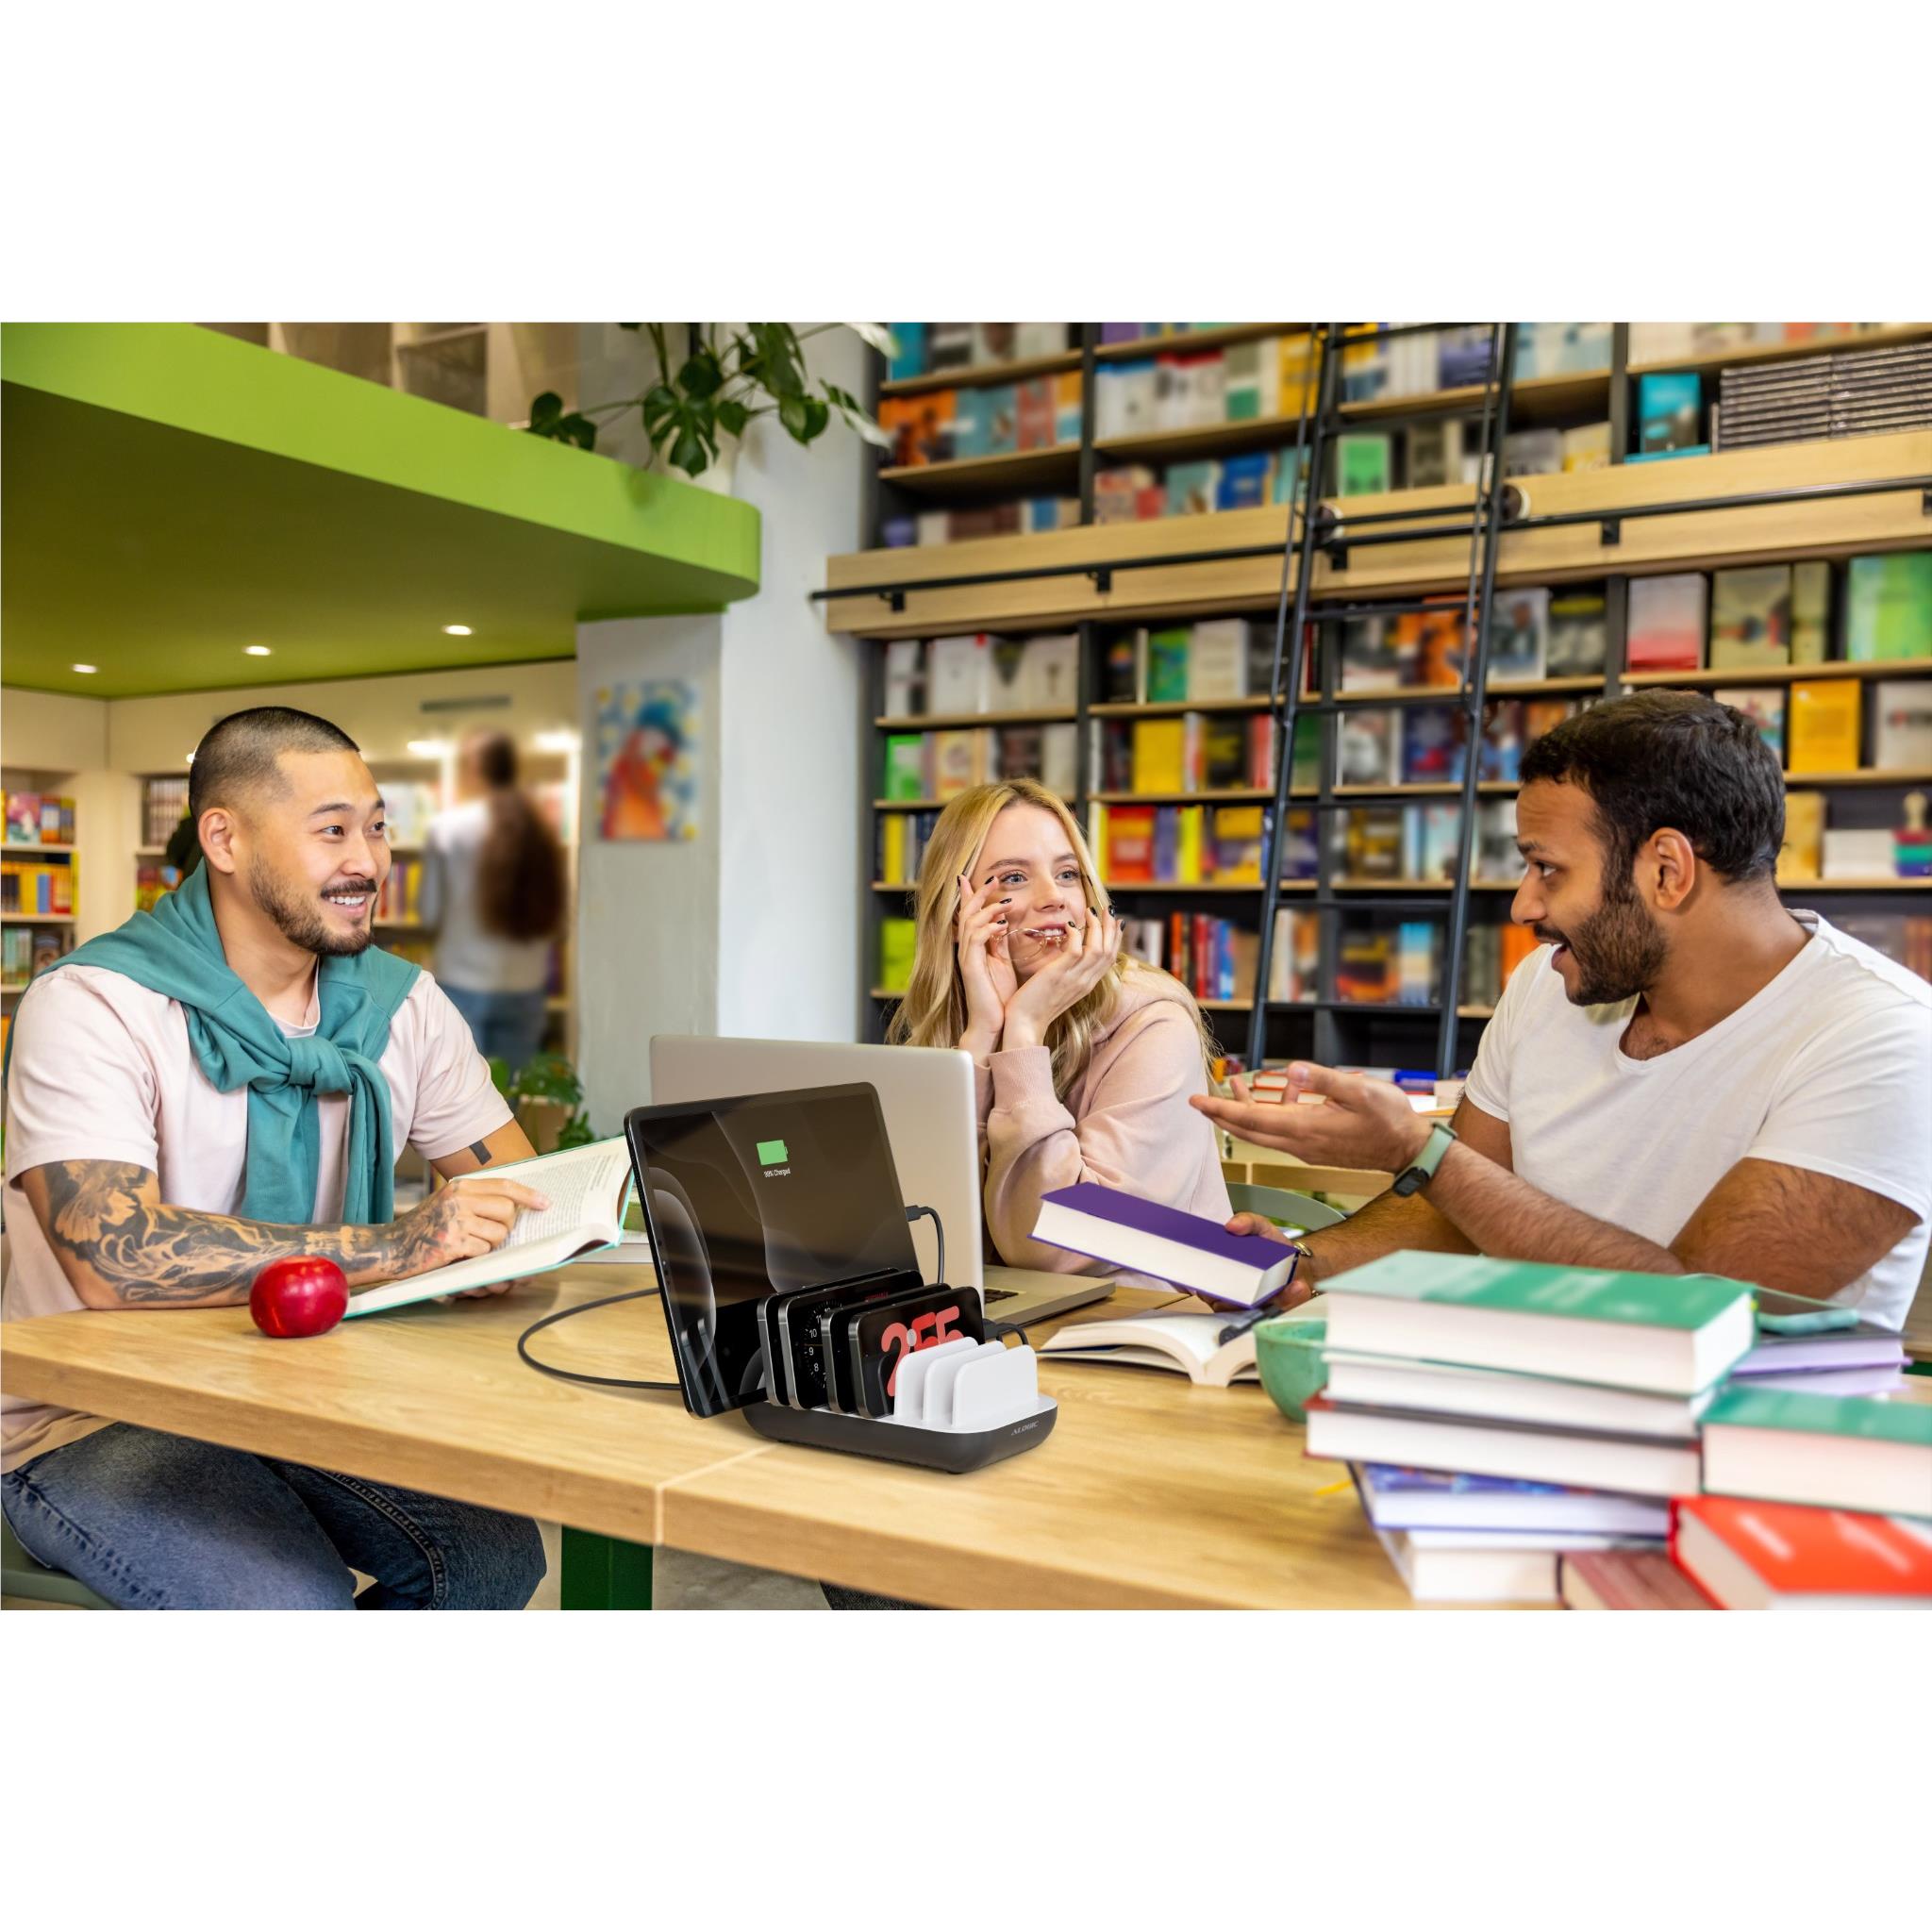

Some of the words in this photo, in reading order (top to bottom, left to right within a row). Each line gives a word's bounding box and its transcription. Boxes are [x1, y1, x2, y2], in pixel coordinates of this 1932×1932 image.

[809, 1328, 817, 1338] 10
[808, 1347, 814, 1356] 9
[813, 1362, 819, 1372] 8
